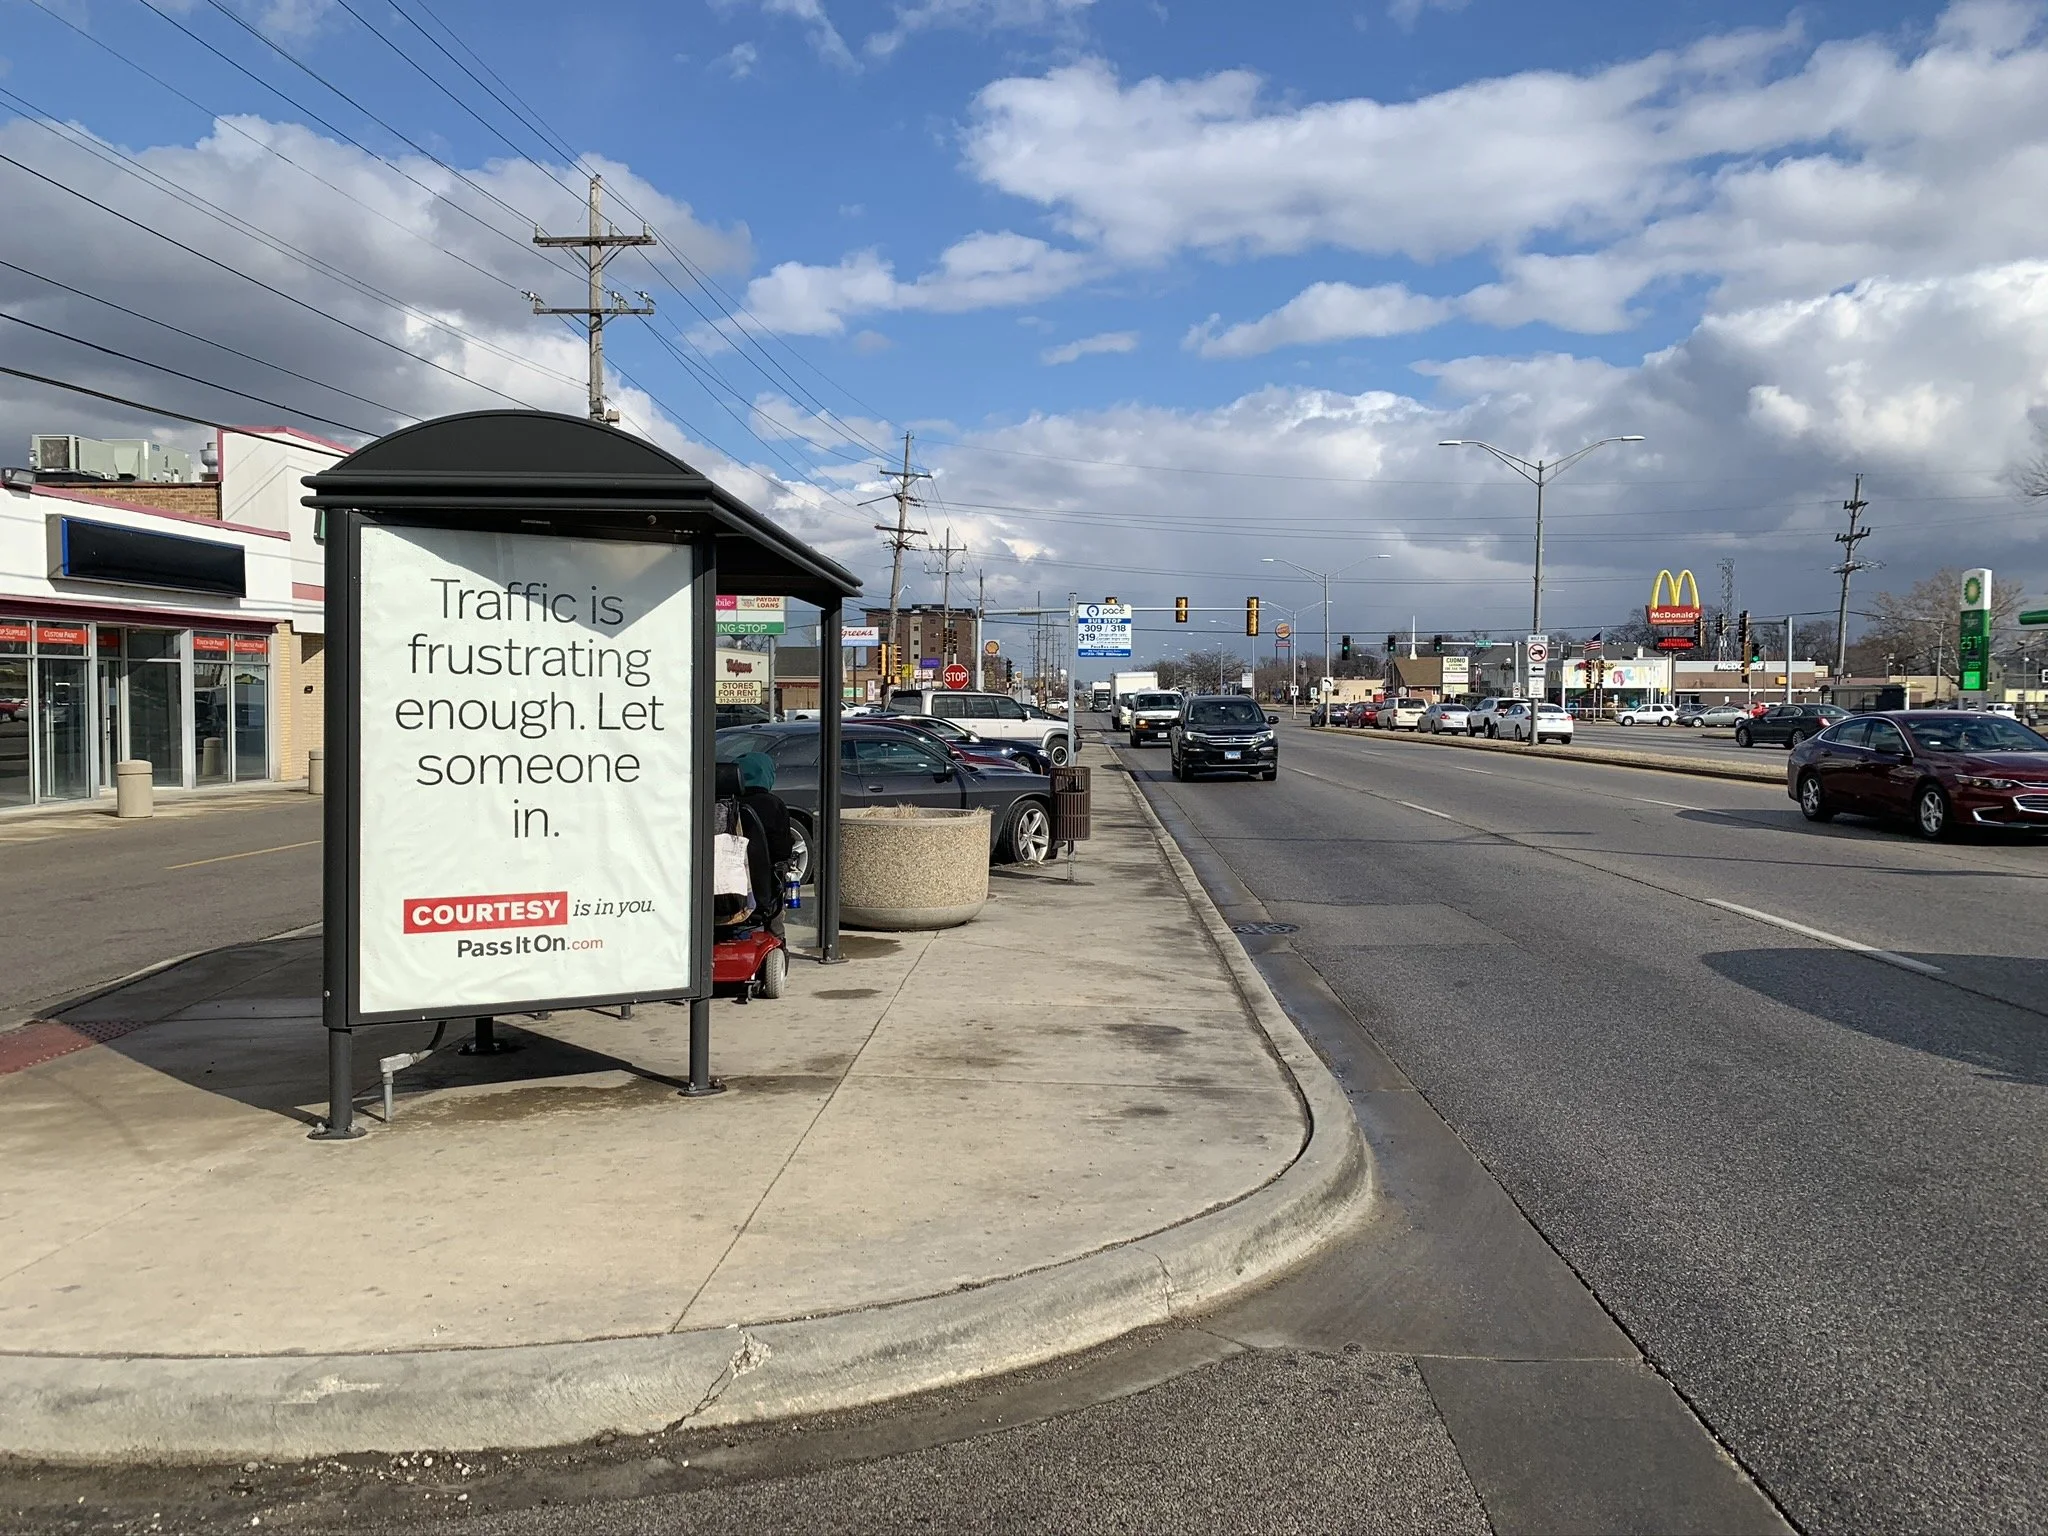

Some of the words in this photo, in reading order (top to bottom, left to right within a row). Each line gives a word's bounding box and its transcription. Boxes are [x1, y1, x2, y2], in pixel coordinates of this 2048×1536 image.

[430, 577, 577, 624] Traffic
[590, 585, 624, 626] is
[716, 598, 732, 607] bile
[1103, 607, 1125, 615] pace
[1078, 633, 1096, 642] 319
[1084, 624, 1103, 632] 309
[1111, 624, 1126, 632] 318
[407, 634, 651, 687] frustrating
[945, 671, 968, 682] STOP
[395, 691, 586, 739] enough.
[598, 692, 665, 732] Let
[416, 753, 641, 785] someone
[513, 799, 560, 838] in.
[411, 899, 561, 926] COURTESY
[573, 900, 592, 917] is
[595, 898, 618, 915] in
[618, 900, 656, 919] you.
[457, 934, 604, 958] PassItOn.com
